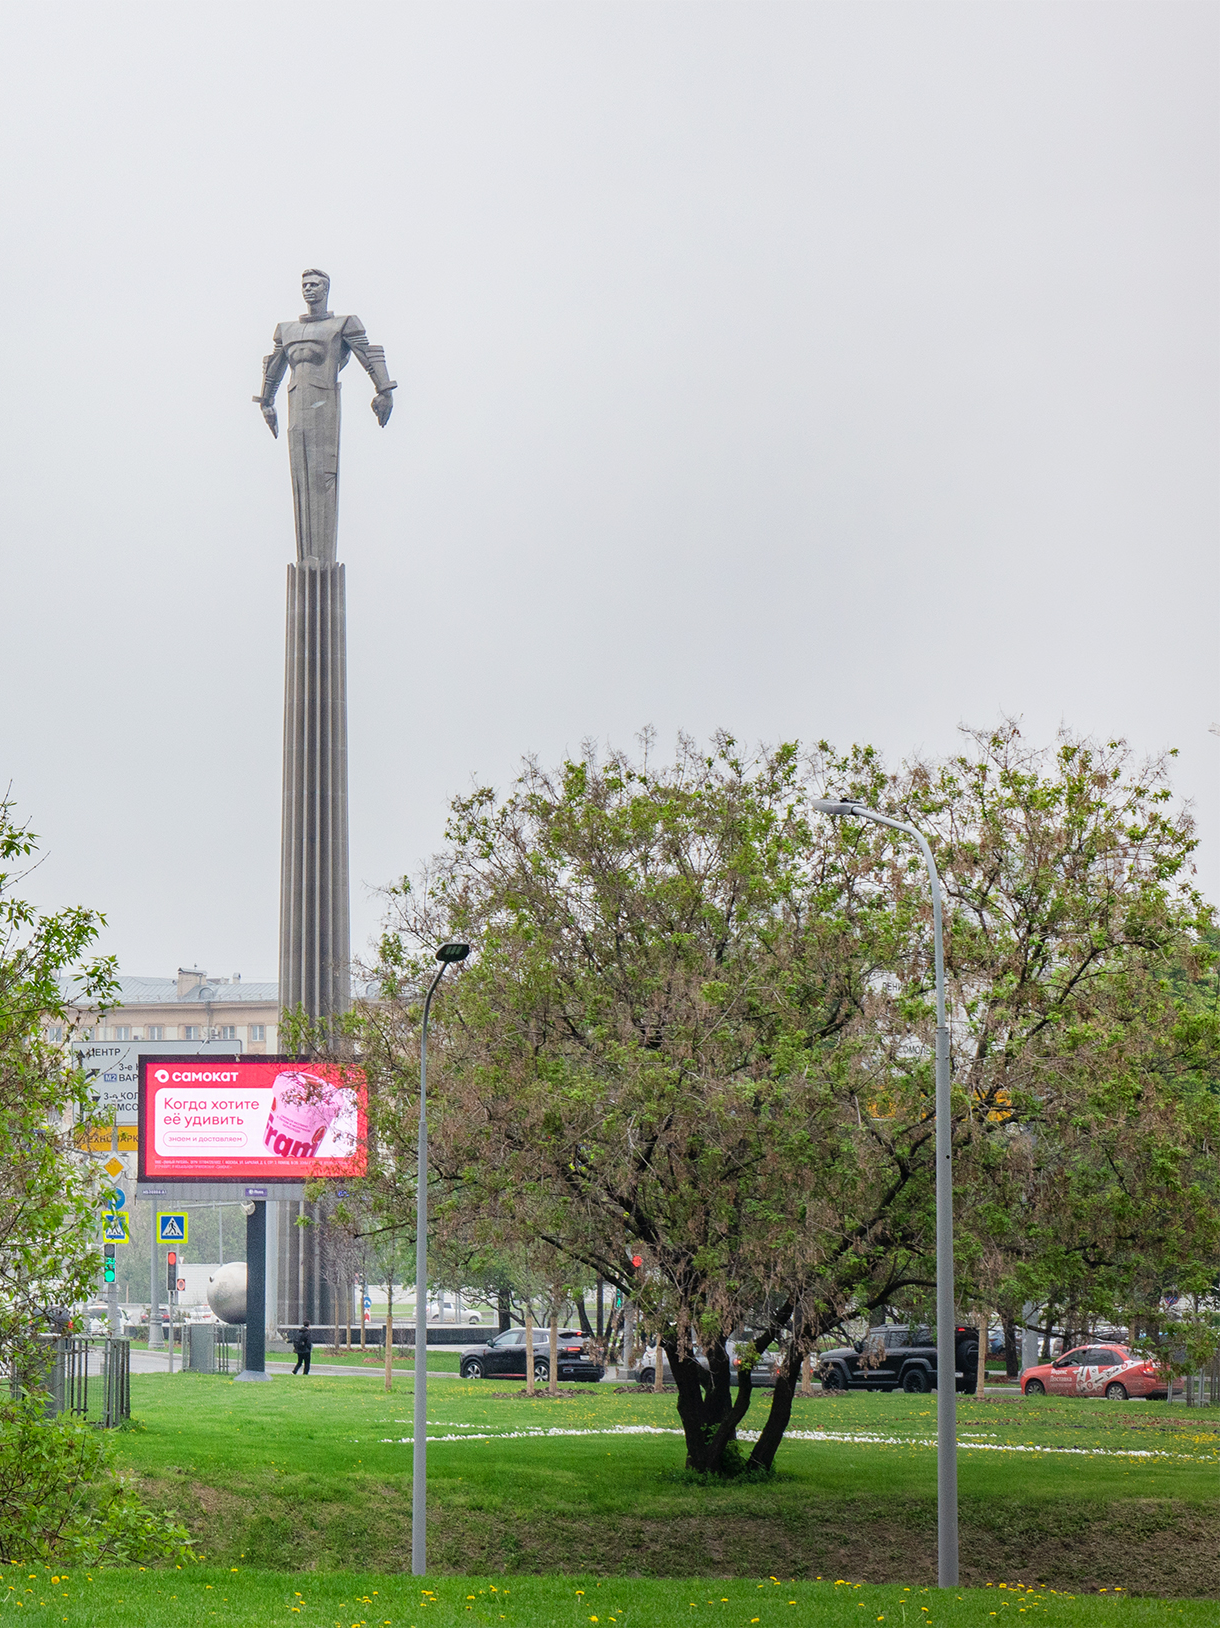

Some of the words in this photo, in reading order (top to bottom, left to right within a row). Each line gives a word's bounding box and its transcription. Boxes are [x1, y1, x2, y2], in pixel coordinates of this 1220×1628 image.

[171, 1072, 239, 1082] самокат
[164, 1097, 207, 1112] Когда
[211, 1100, 260, 1110] хотите
[163, 1112, 182, 1125] её
[184, 1116, 244, 1129] удивить
